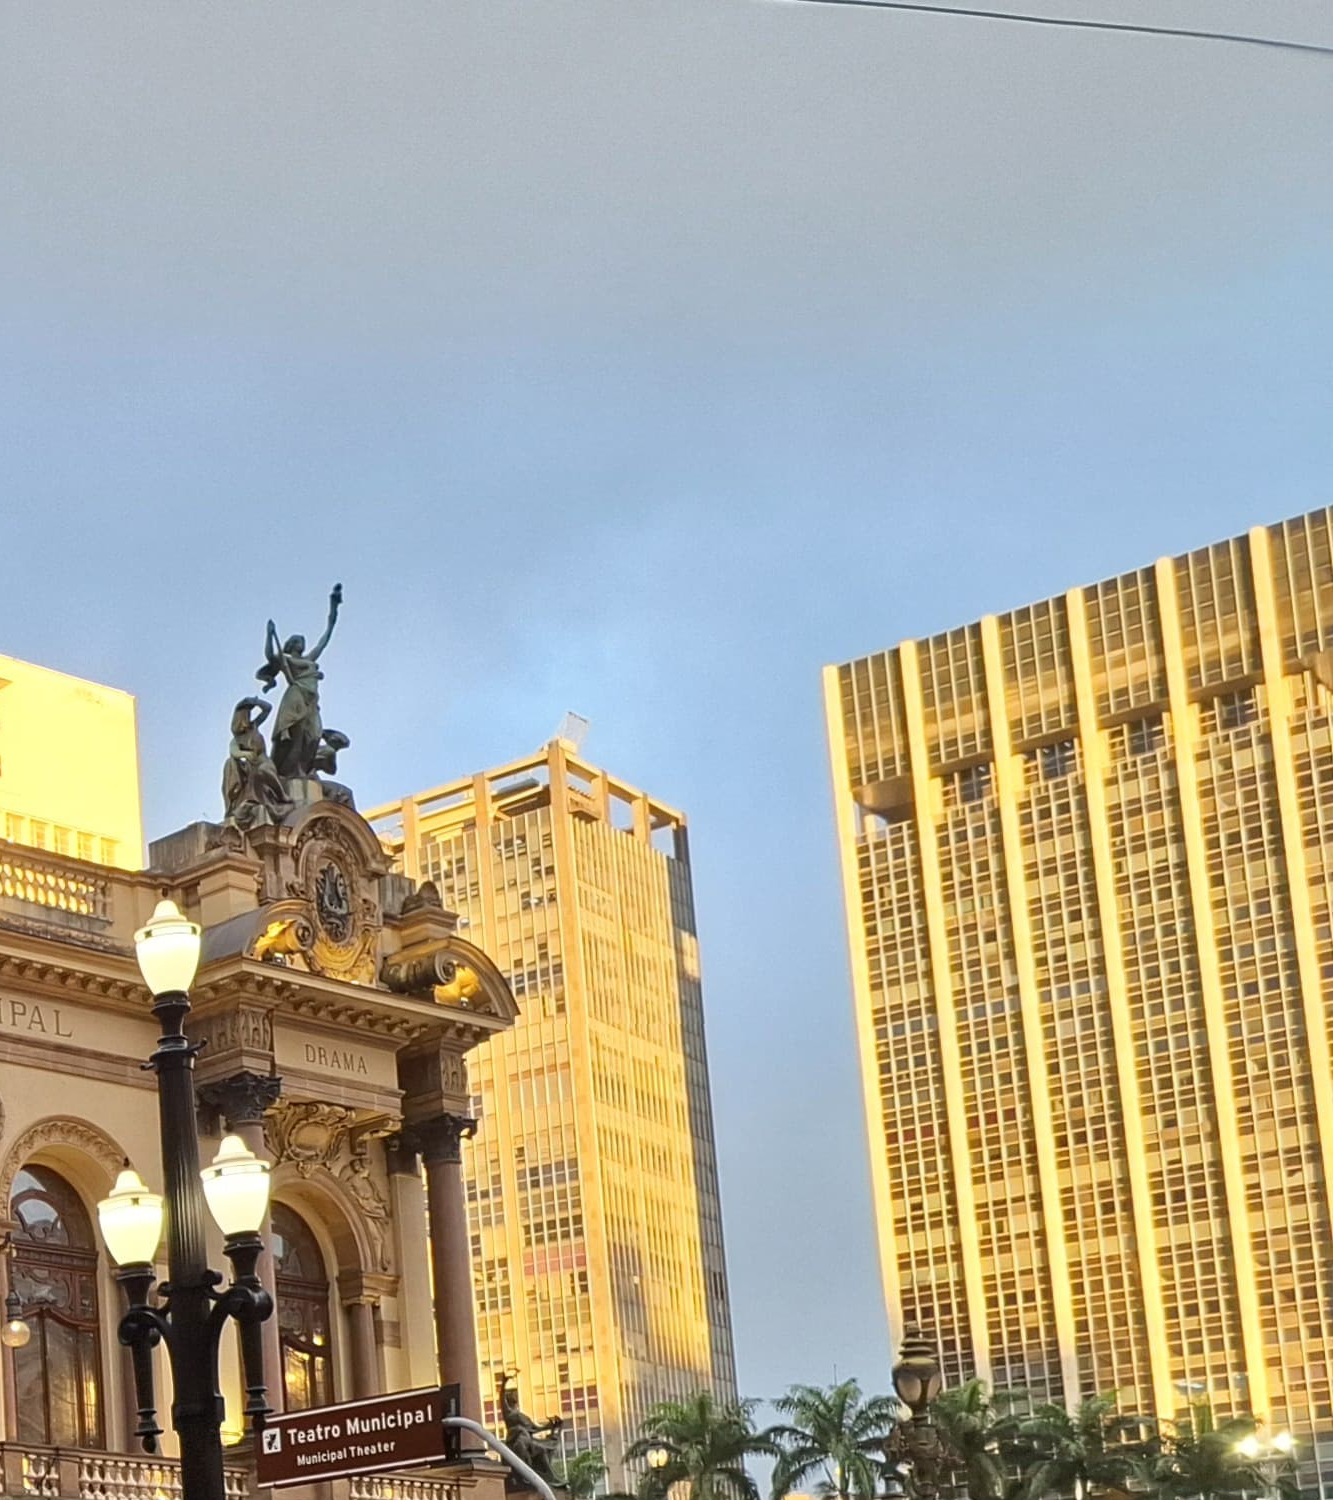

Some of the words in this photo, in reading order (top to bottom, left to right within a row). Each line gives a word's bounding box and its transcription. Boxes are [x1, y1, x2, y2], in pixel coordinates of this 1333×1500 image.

[305, 1043, 368, 1075] DRAMA
[287, 1424, 341, 1446] Teatro
[346, 1404, 433, 1437] Municipal
[296, 1442, 347, 1467] Municipal
[349, 1441, 395, 1459] Theater
